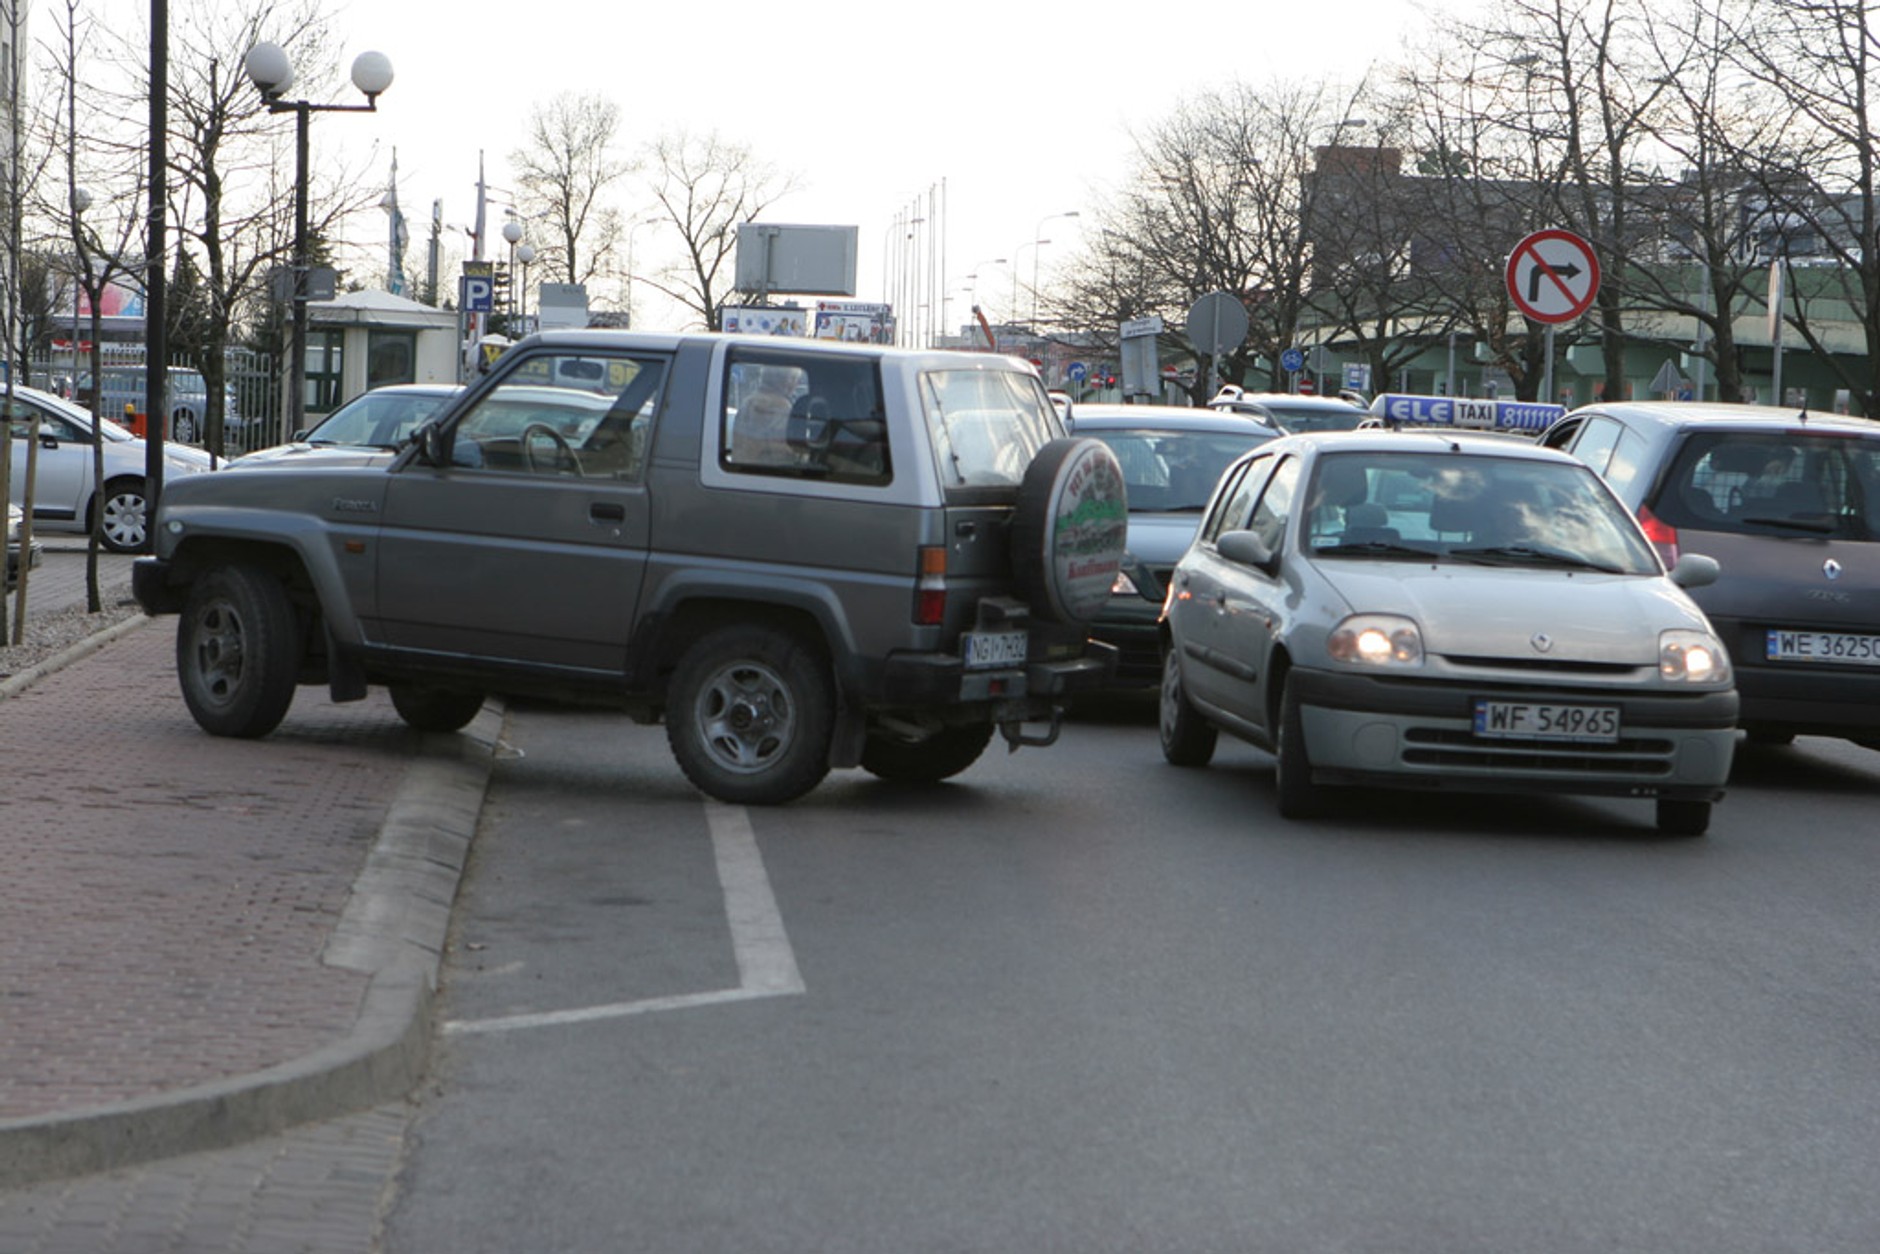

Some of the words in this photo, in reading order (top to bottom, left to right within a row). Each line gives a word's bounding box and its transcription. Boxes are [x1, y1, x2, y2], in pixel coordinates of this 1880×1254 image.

[466, 280, 490, 310] P
[1391, 400, 1449, 421] ELE
[1458, 403, 1493, 421] TAXI
[1780, 633, 1812, 655] WE
[1490, 705, 1529, 731] WF
[1537, 707, 1616, 734] 54965
